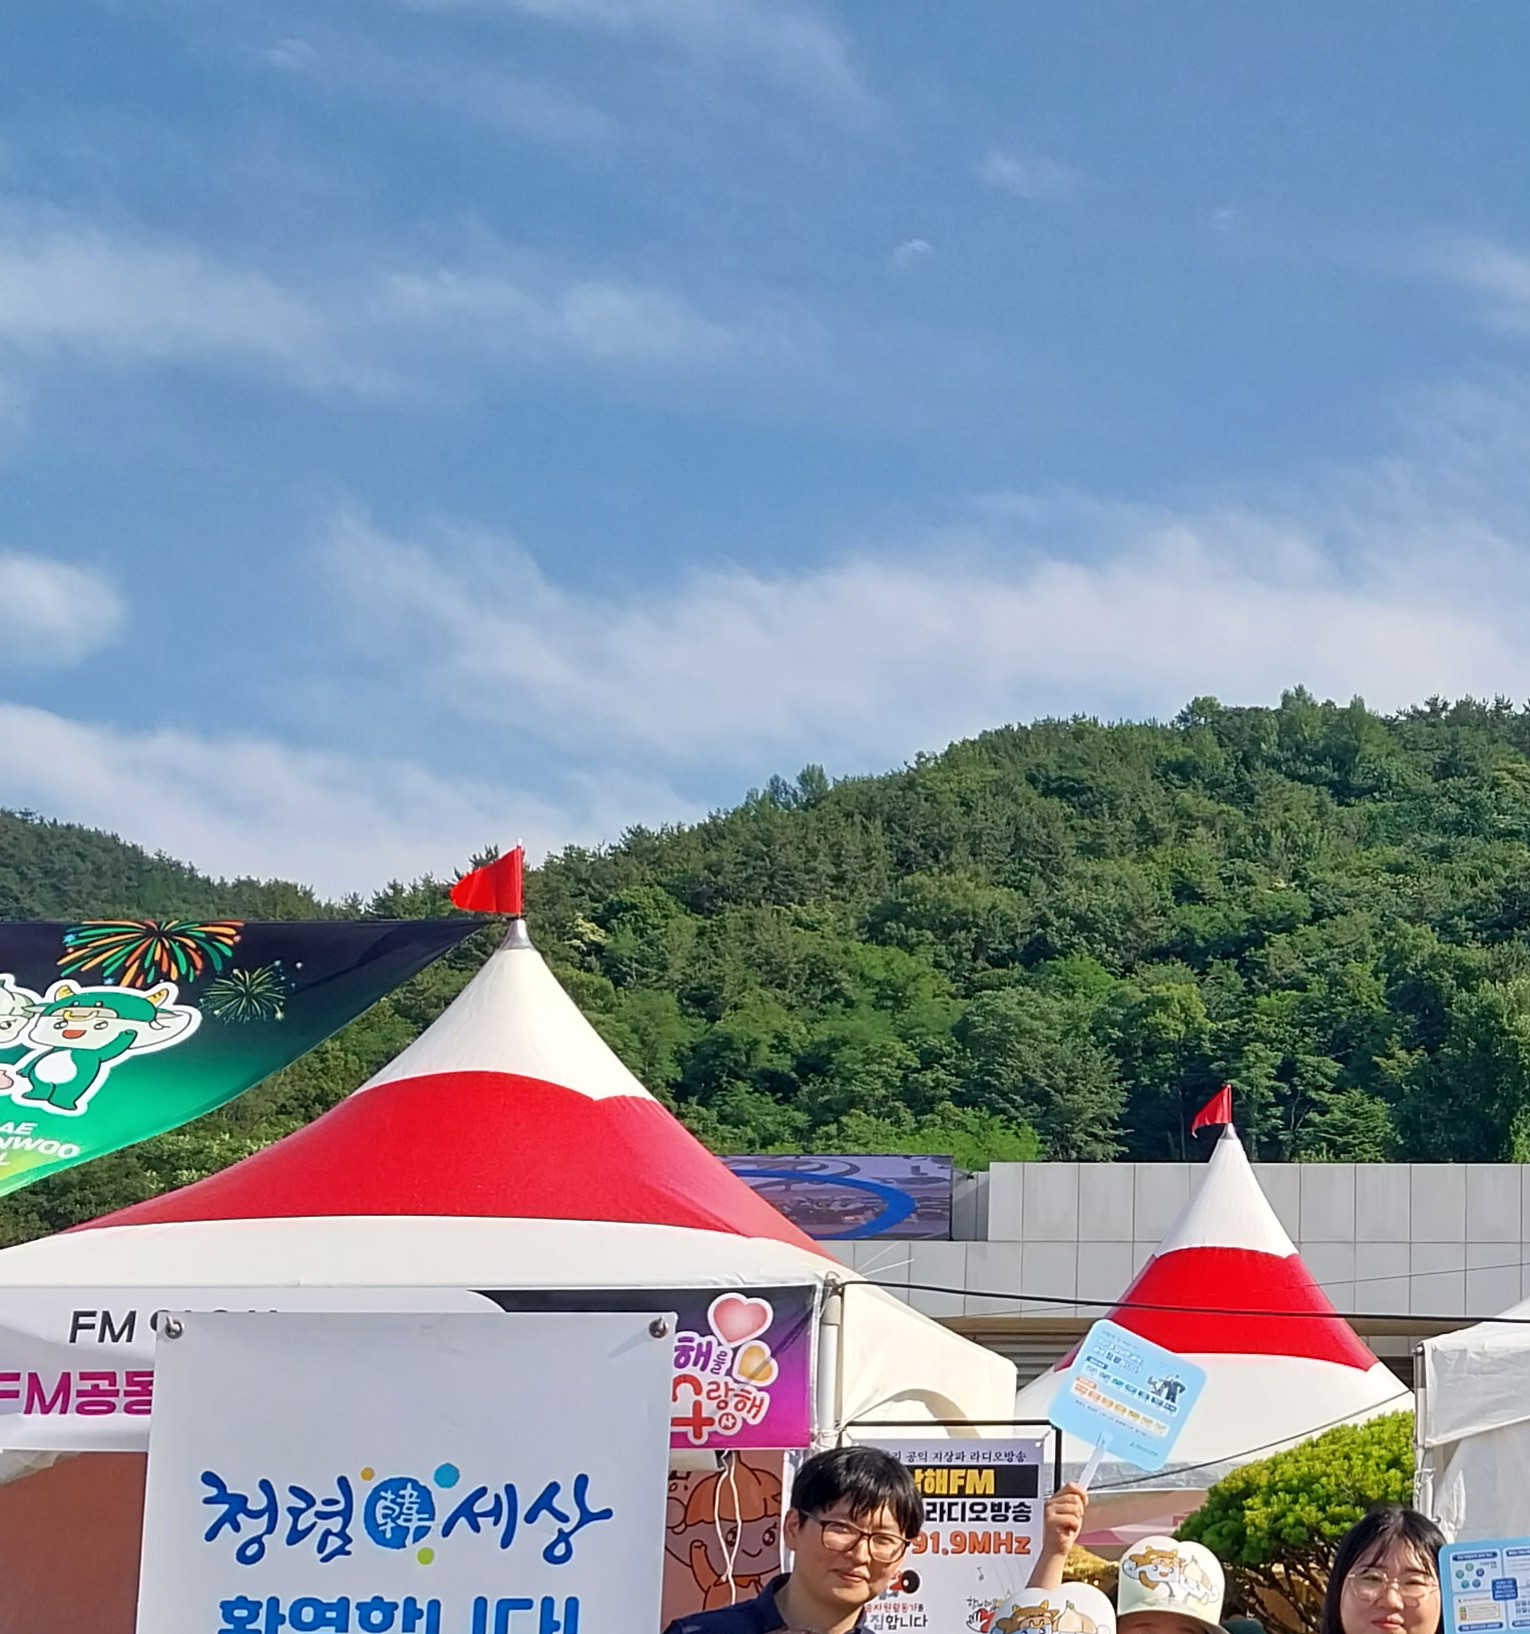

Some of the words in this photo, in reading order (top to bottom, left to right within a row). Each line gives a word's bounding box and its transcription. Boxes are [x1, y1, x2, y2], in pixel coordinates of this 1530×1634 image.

[932, 1450, 966, 1463] 지상파
[970, 1450, 1027, 1463] 라디오방송
[911, 1530, 1032, 1555] 91.9MHz
[867, 1613, 929, 1630] 집합니다
